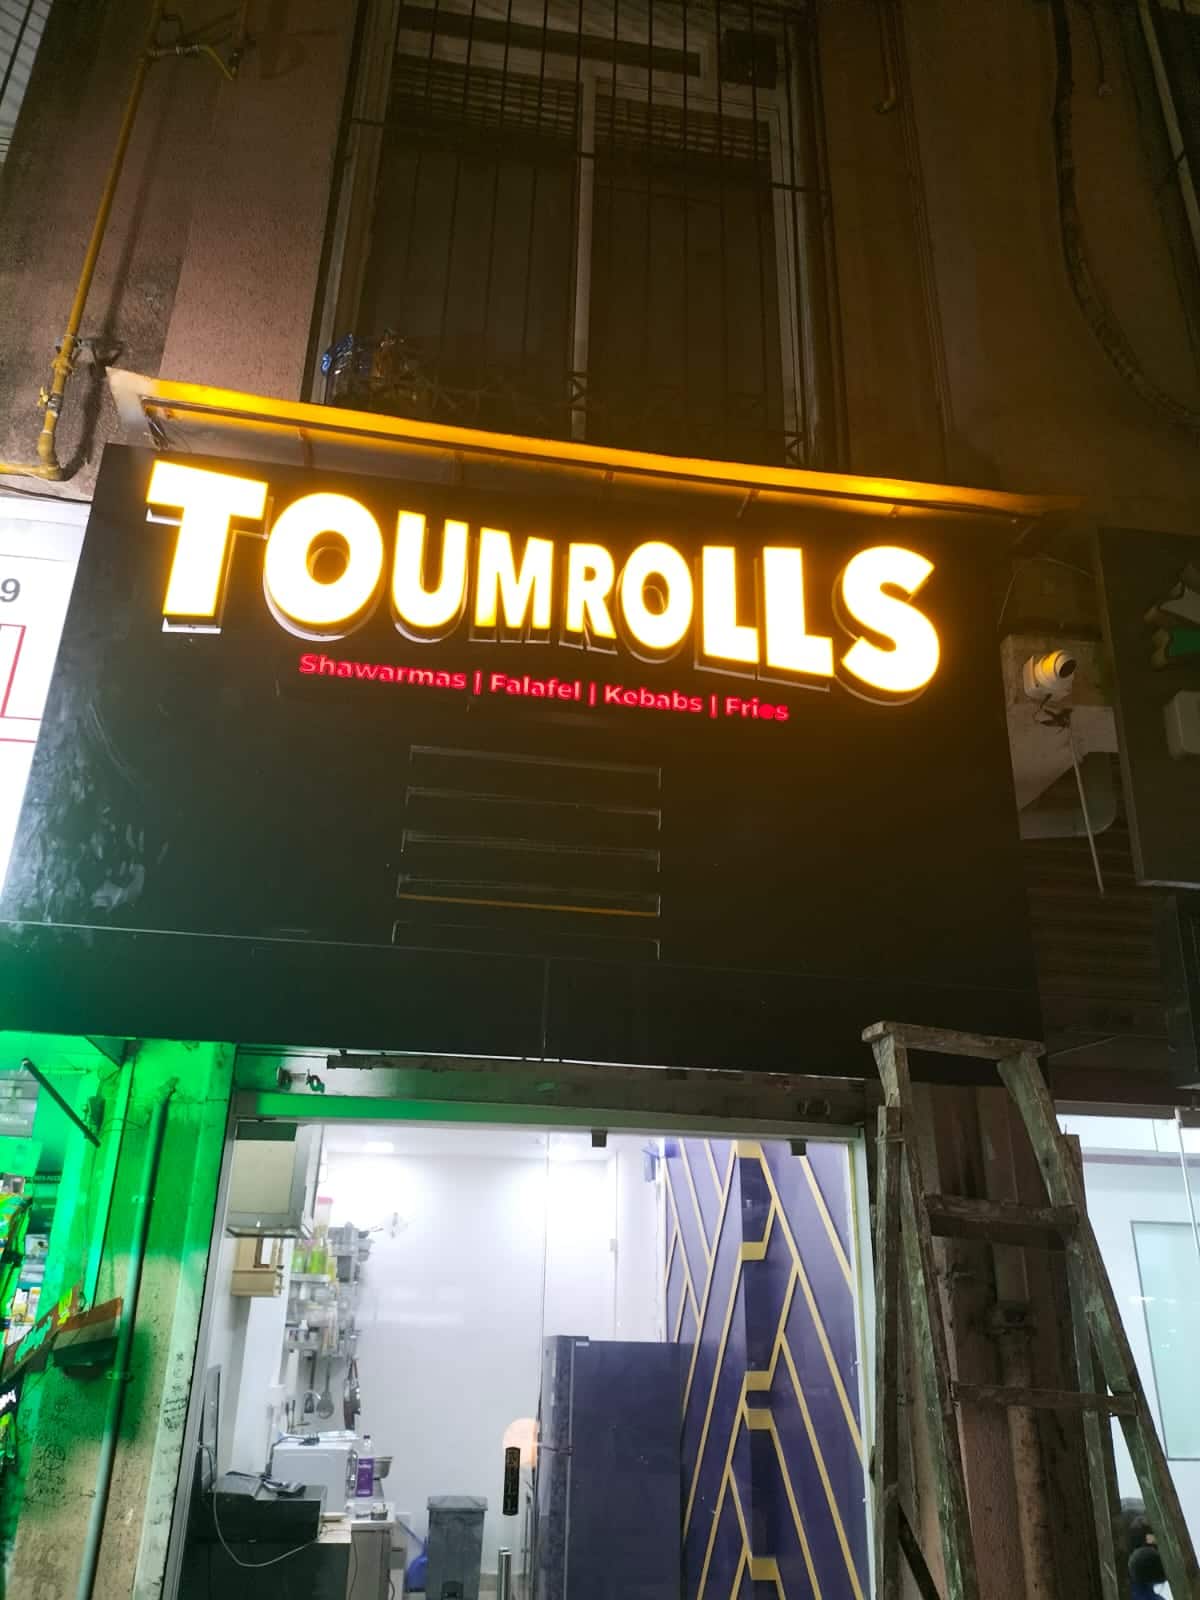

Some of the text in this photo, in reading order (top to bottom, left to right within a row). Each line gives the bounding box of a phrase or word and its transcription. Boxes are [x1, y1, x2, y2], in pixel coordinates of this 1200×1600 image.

[146, 459, 940, 692] TOUMROLLS
[298, 653, 468, 690] Shawarmas
[489, 672, 582, 701] Falafel
[603, 684, 704, 713] Kebabs
[723, 695, 790, 721] Fries
